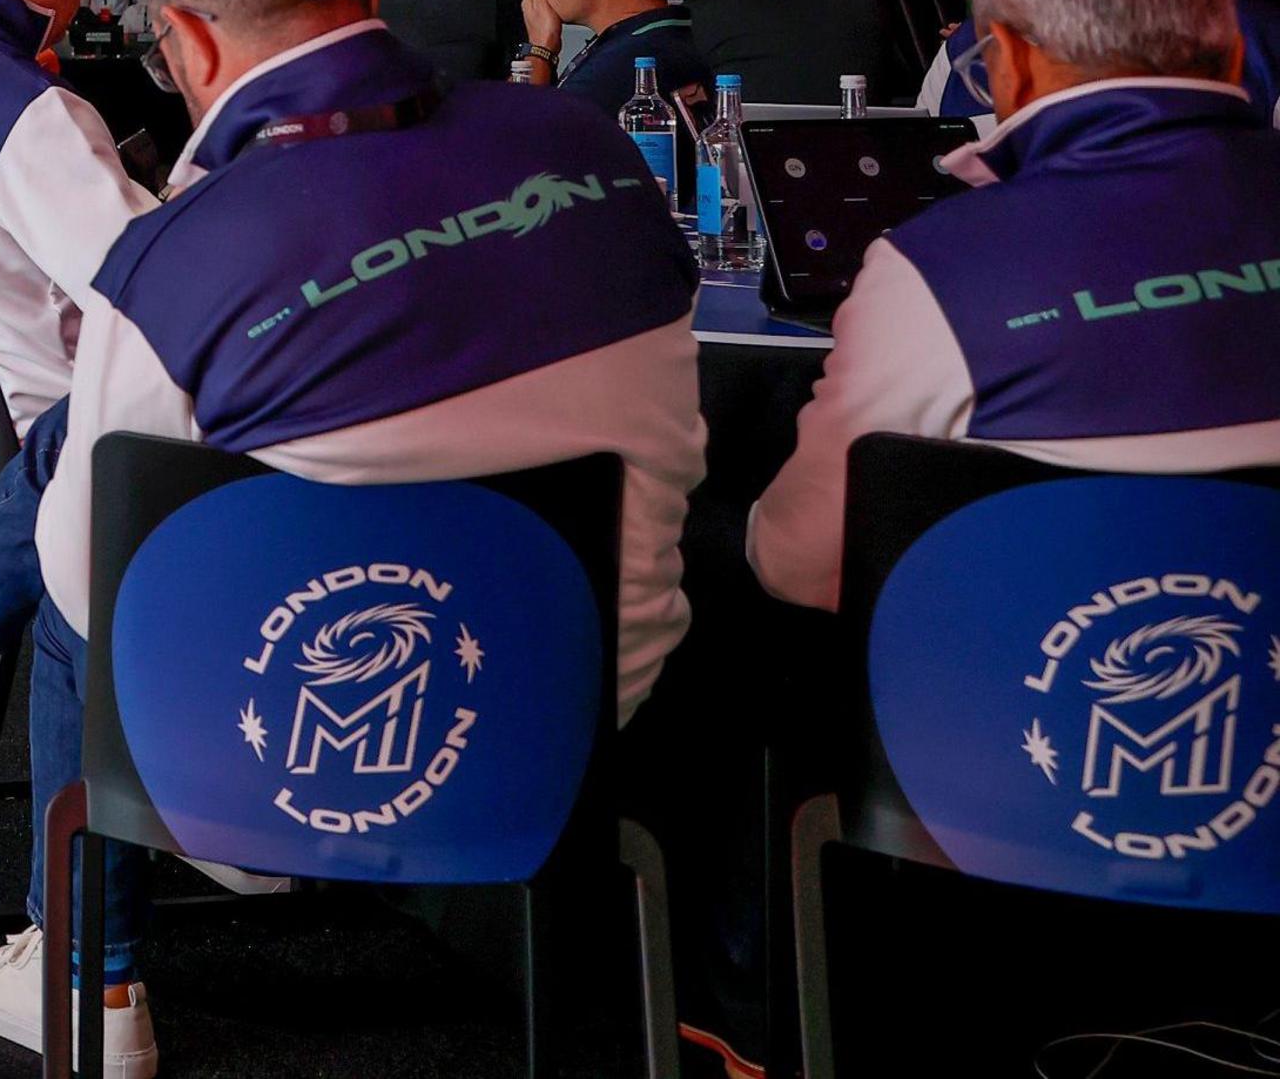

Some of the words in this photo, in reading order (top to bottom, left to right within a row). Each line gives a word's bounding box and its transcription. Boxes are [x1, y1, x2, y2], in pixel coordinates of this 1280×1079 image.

[300, 171, 606, 310] LONDON
[1073, 258, 1280, 321] LON
[244, 563, 454, 675] LONDON
[1023, 574, 1261, 693] LONDON
[273, 706, 479, 835] LONDON
